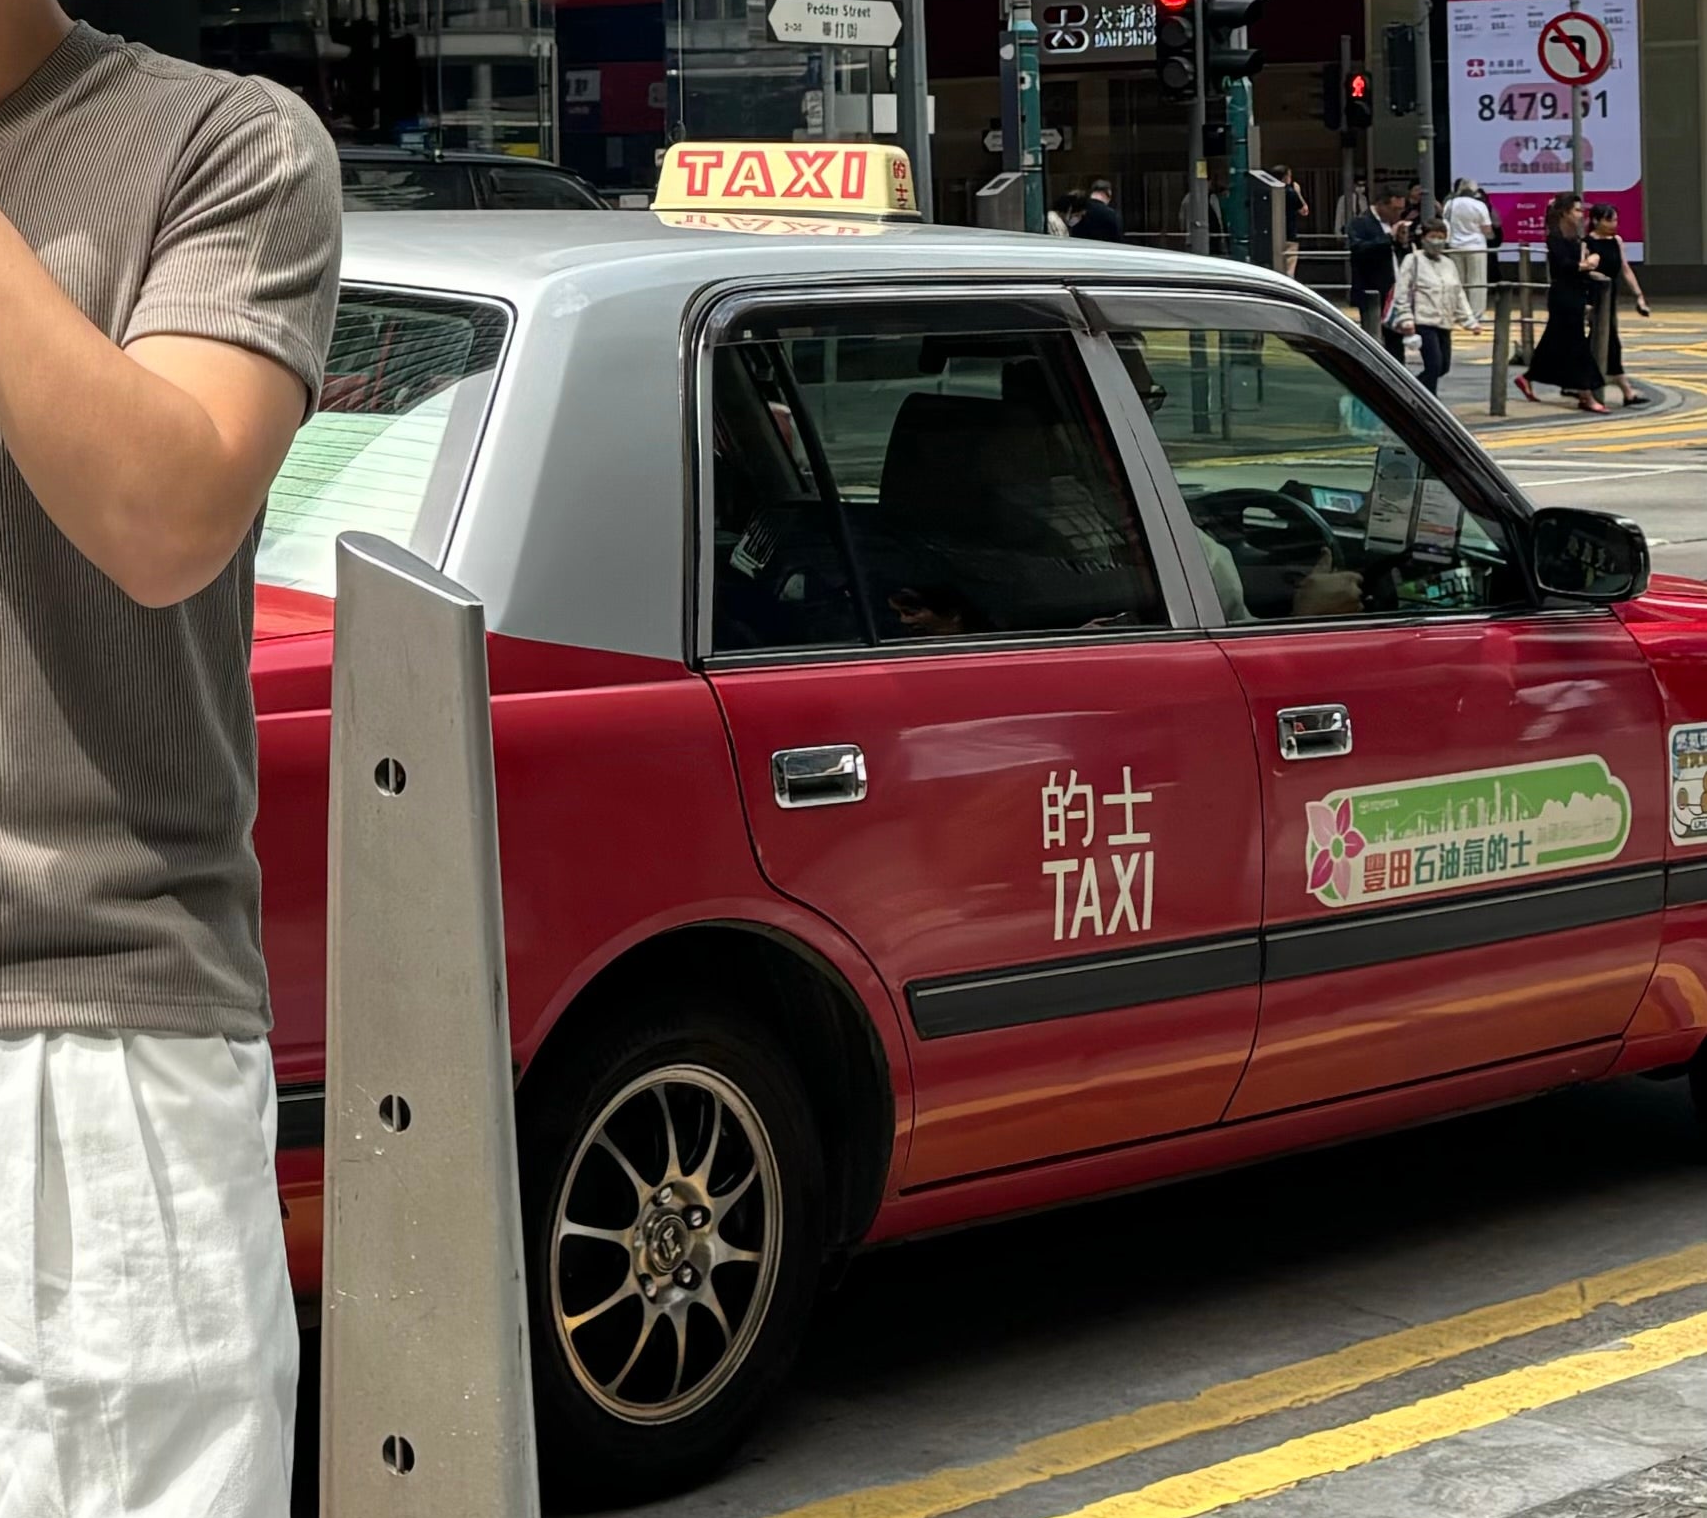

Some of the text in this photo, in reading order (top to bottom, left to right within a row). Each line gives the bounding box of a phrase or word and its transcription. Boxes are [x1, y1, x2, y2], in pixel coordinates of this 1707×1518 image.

[806, 2, 871, 19] Pedder Street
[677, 150, 868, 200] TAXI
[1041, 766, 1154, 850] 的士
[1362, 829, 1533, 895] 豐田石油氣的士
[1042, 850, 1156, 941] TAXI
